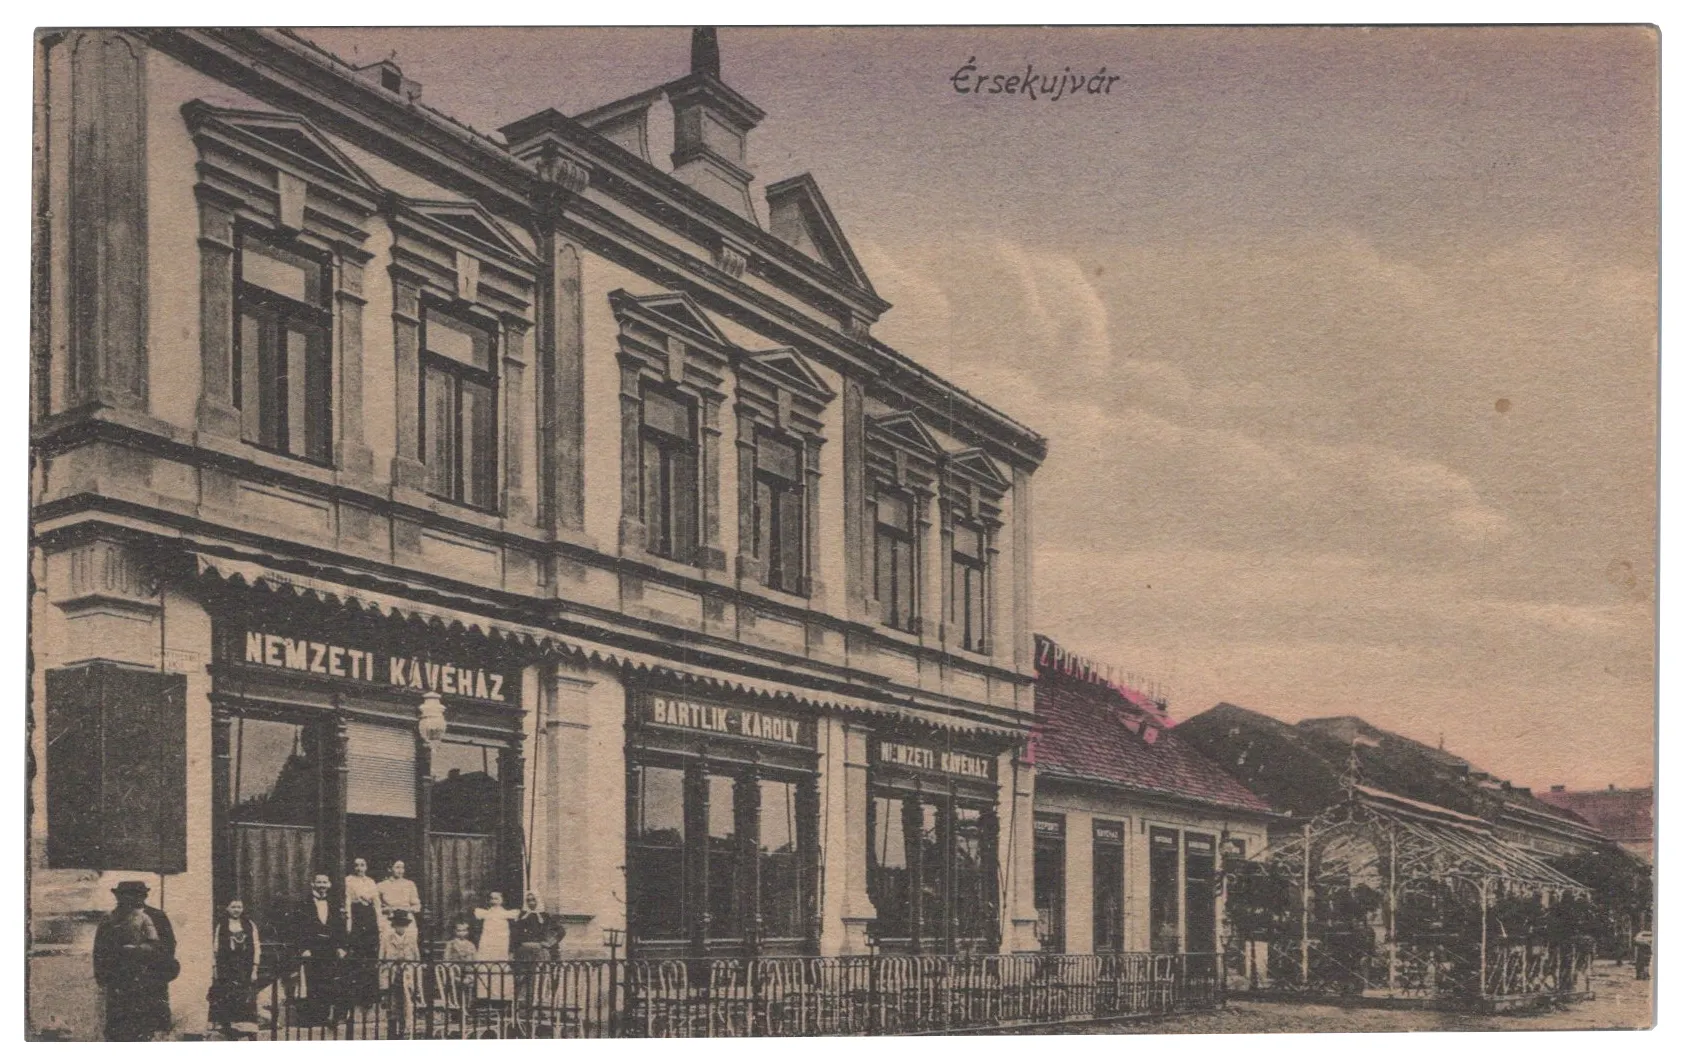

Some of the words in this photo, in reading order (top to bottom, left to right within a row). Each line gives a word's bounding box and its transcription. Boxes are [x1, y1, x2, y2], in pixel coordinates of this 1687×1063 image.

[246, 631, 373, 681] NEMZETI
[390, 656, 505, 701] KÁVÉHÁZ
[654, 698, 728, 732] BARTLIK
